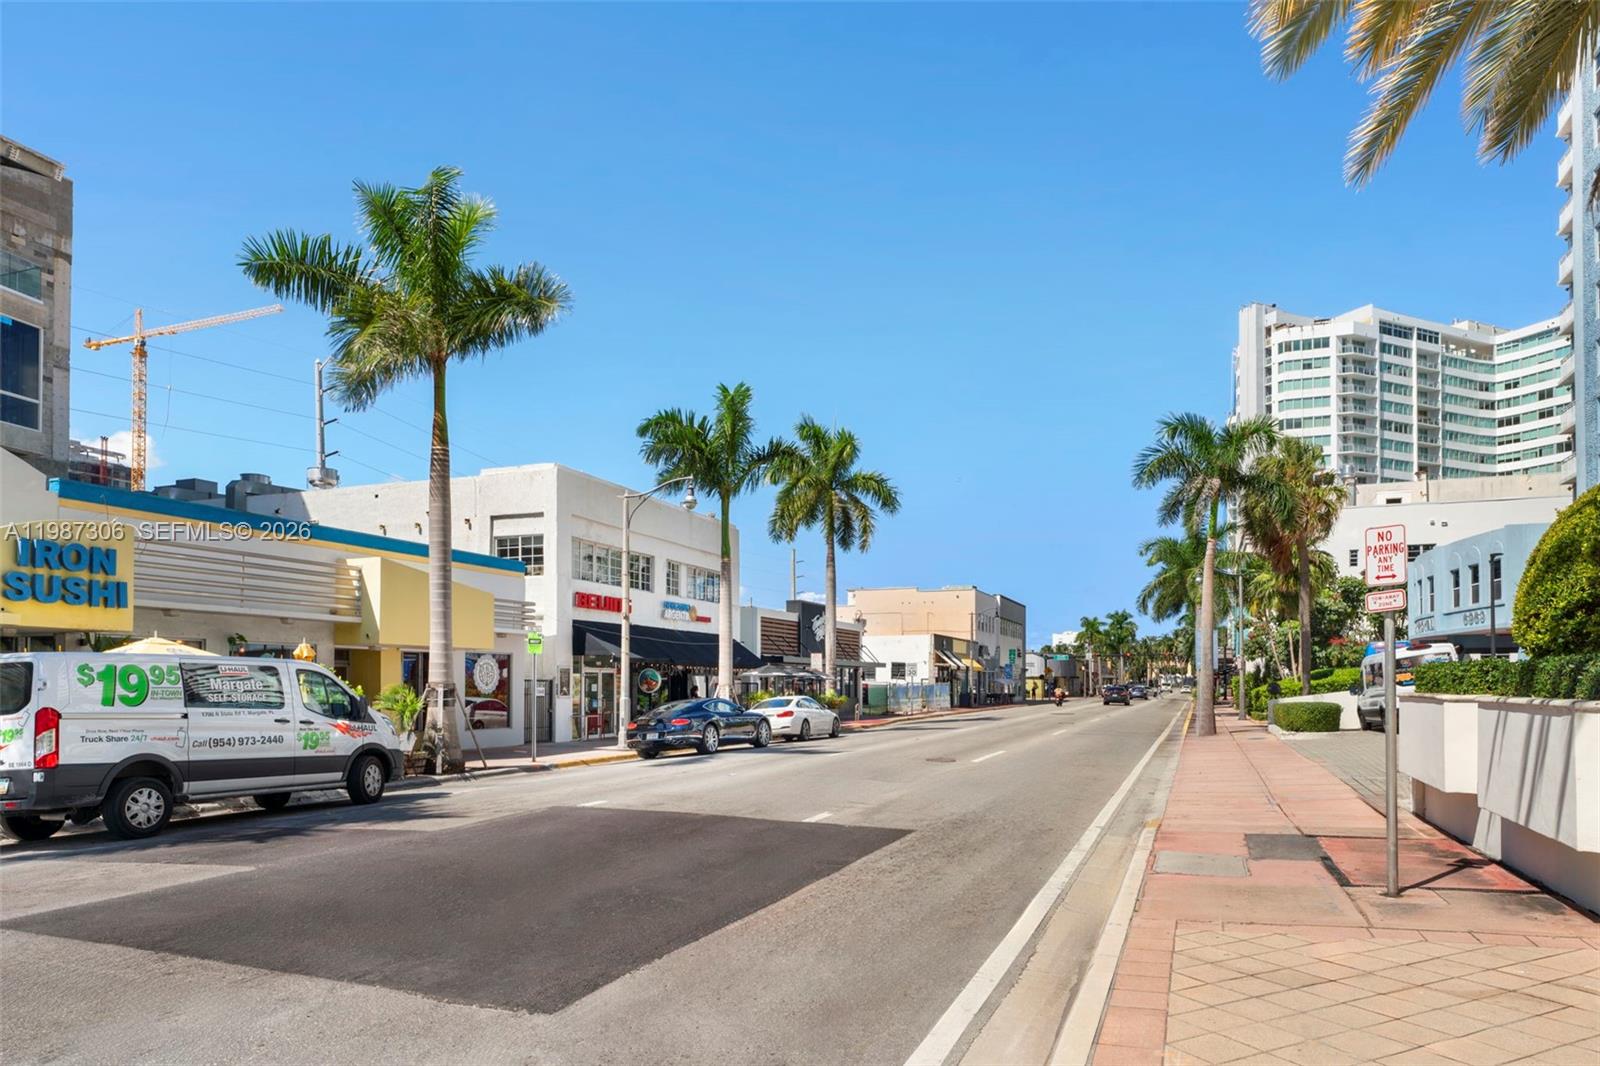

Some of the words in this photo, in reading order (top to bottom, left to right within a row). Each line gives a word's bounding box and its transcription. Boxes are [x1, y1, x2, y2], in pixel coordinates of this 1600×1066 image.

[1377, 530, 1393, 542] NO
[1367, 543, 1404, 556] PARKING
[16, 537, 118, 576] IRON
[1378, 556, 1393, 564] ANY
[1377, 564, 1394, 572] TIME
[2, 572, 129, 609] SUSHI
[210, 679, 264, 692] Margate
[80, 735, 104, 743] Truck
[130, 734, 148, 743] 24/7
[192, 740, 208, 748] Call
[208, 737, 236, 748] (954)
[238, 735, 284, 746] 973-2440
